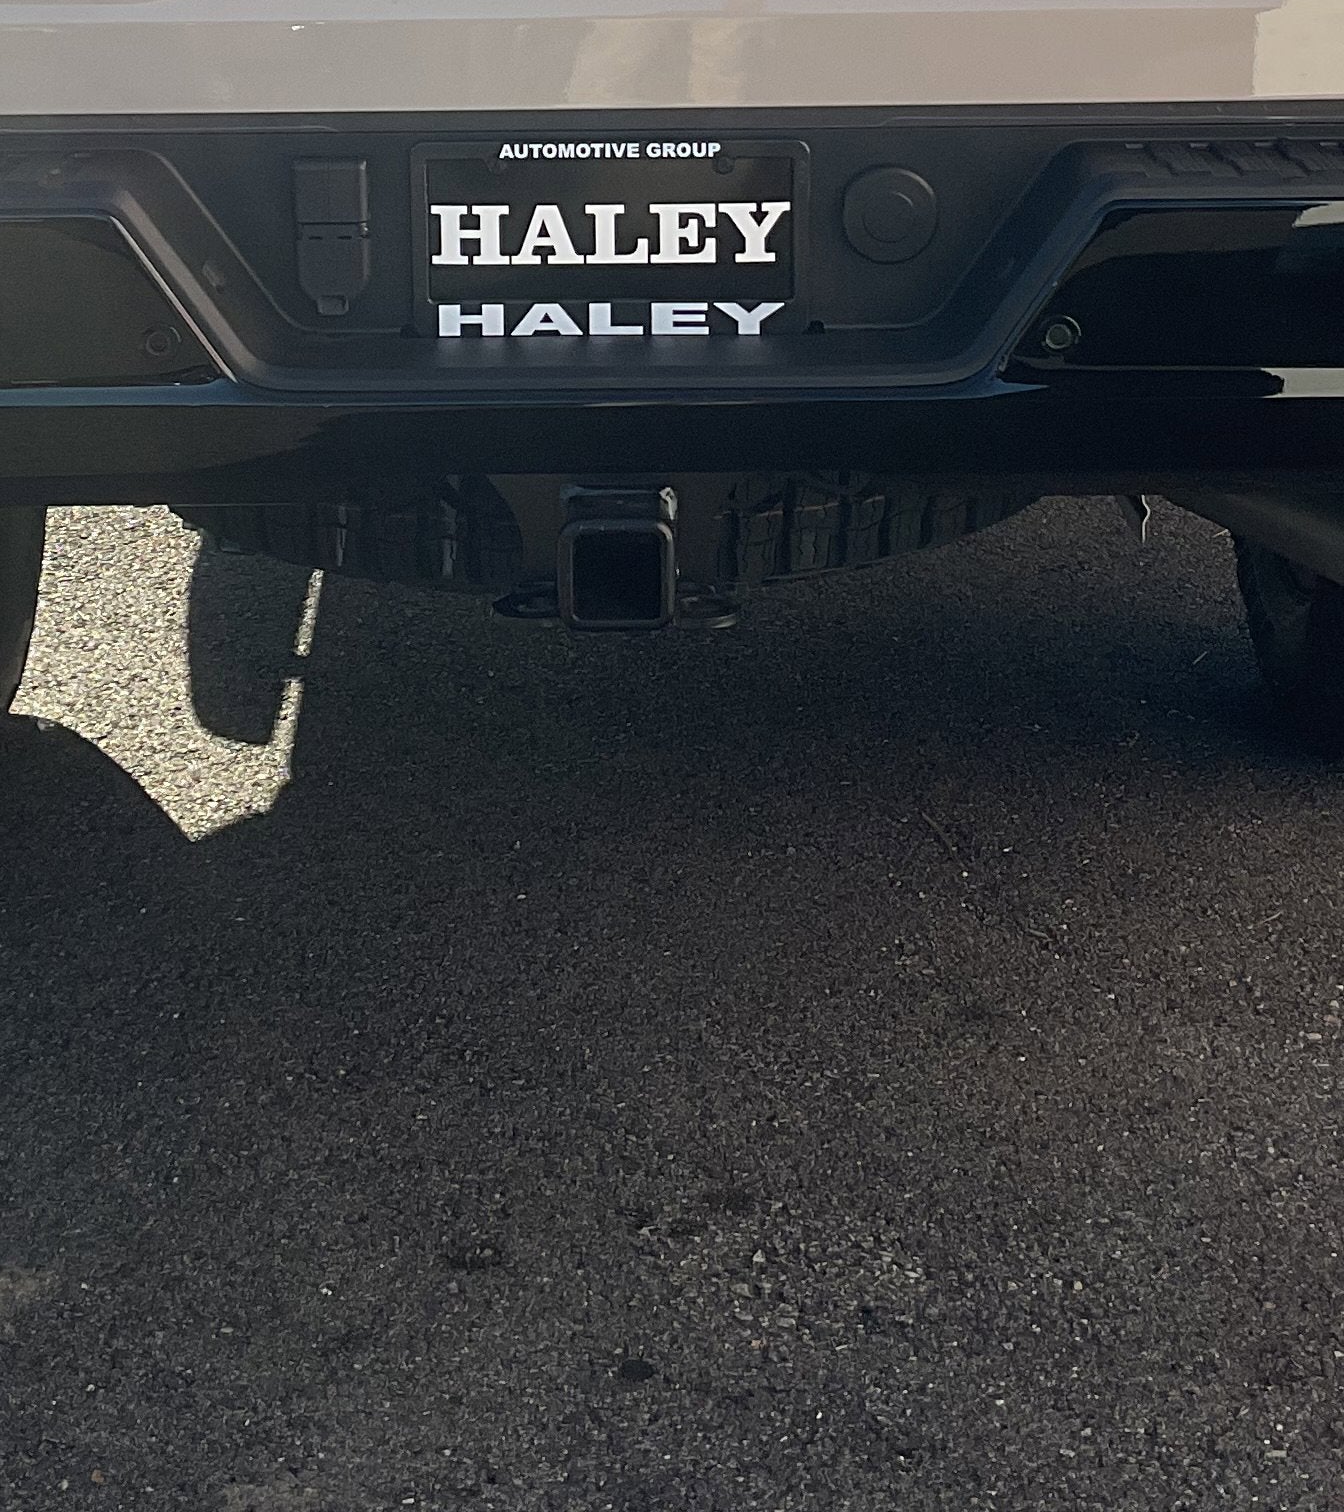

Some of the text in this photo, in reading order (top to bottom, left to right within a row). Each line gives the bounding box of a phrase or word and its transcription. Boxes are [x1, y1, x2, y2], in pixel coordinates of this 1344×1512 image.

[498, 142, 721, 159] AUTOMOTIVE GROUP
[431, 201, 791, 265] HALEY
[437, 301, 786, 336] HALEY
